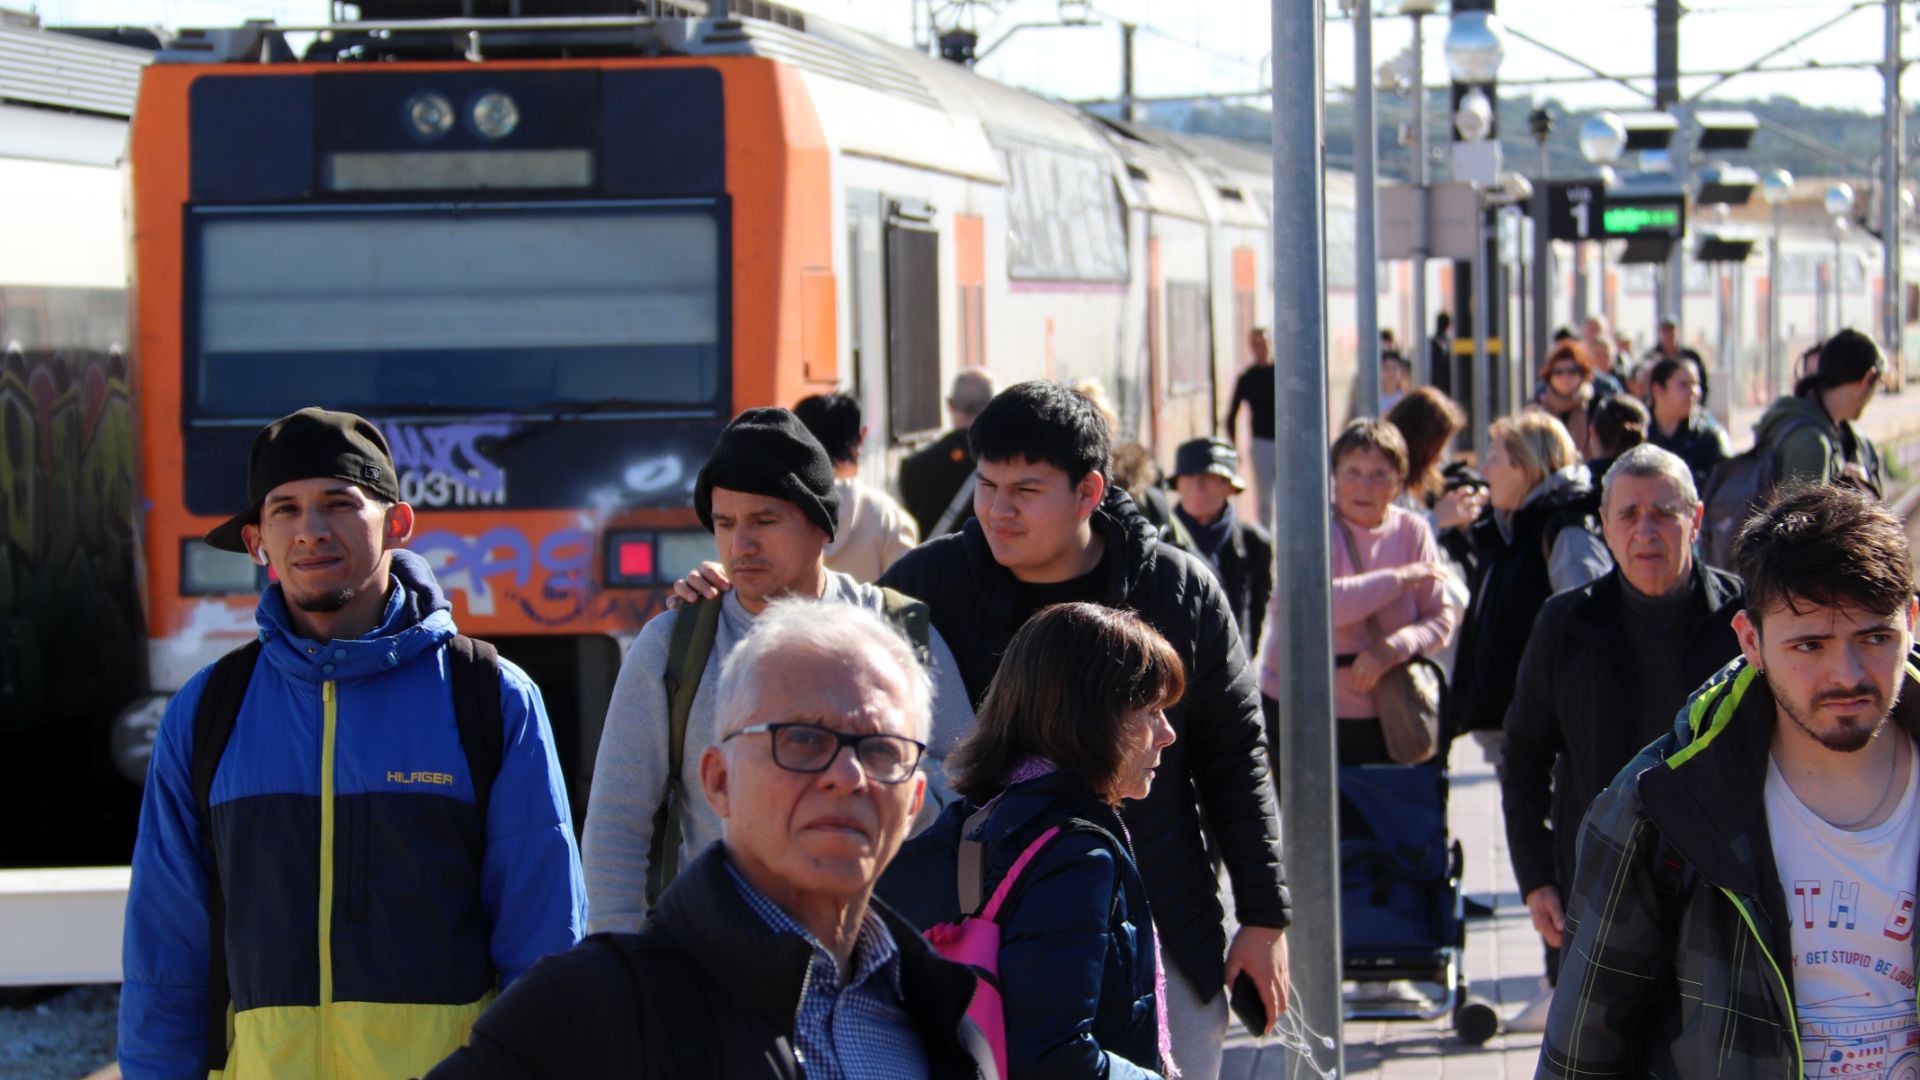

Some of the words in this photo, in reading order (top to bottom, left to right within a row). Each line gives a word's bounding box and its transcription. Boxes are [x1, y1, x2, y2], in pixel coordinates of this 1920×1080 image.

[1570, 202, 1589, 237] 1
[387, 771, 453, 785] HILFIGER
[1806, 951, 1829, 966] GET
[1831, 950, 1872, 968] STUPID
[1874, 959, 1893, 976] BE
[1889, 966, 1916, 990] LOUD
